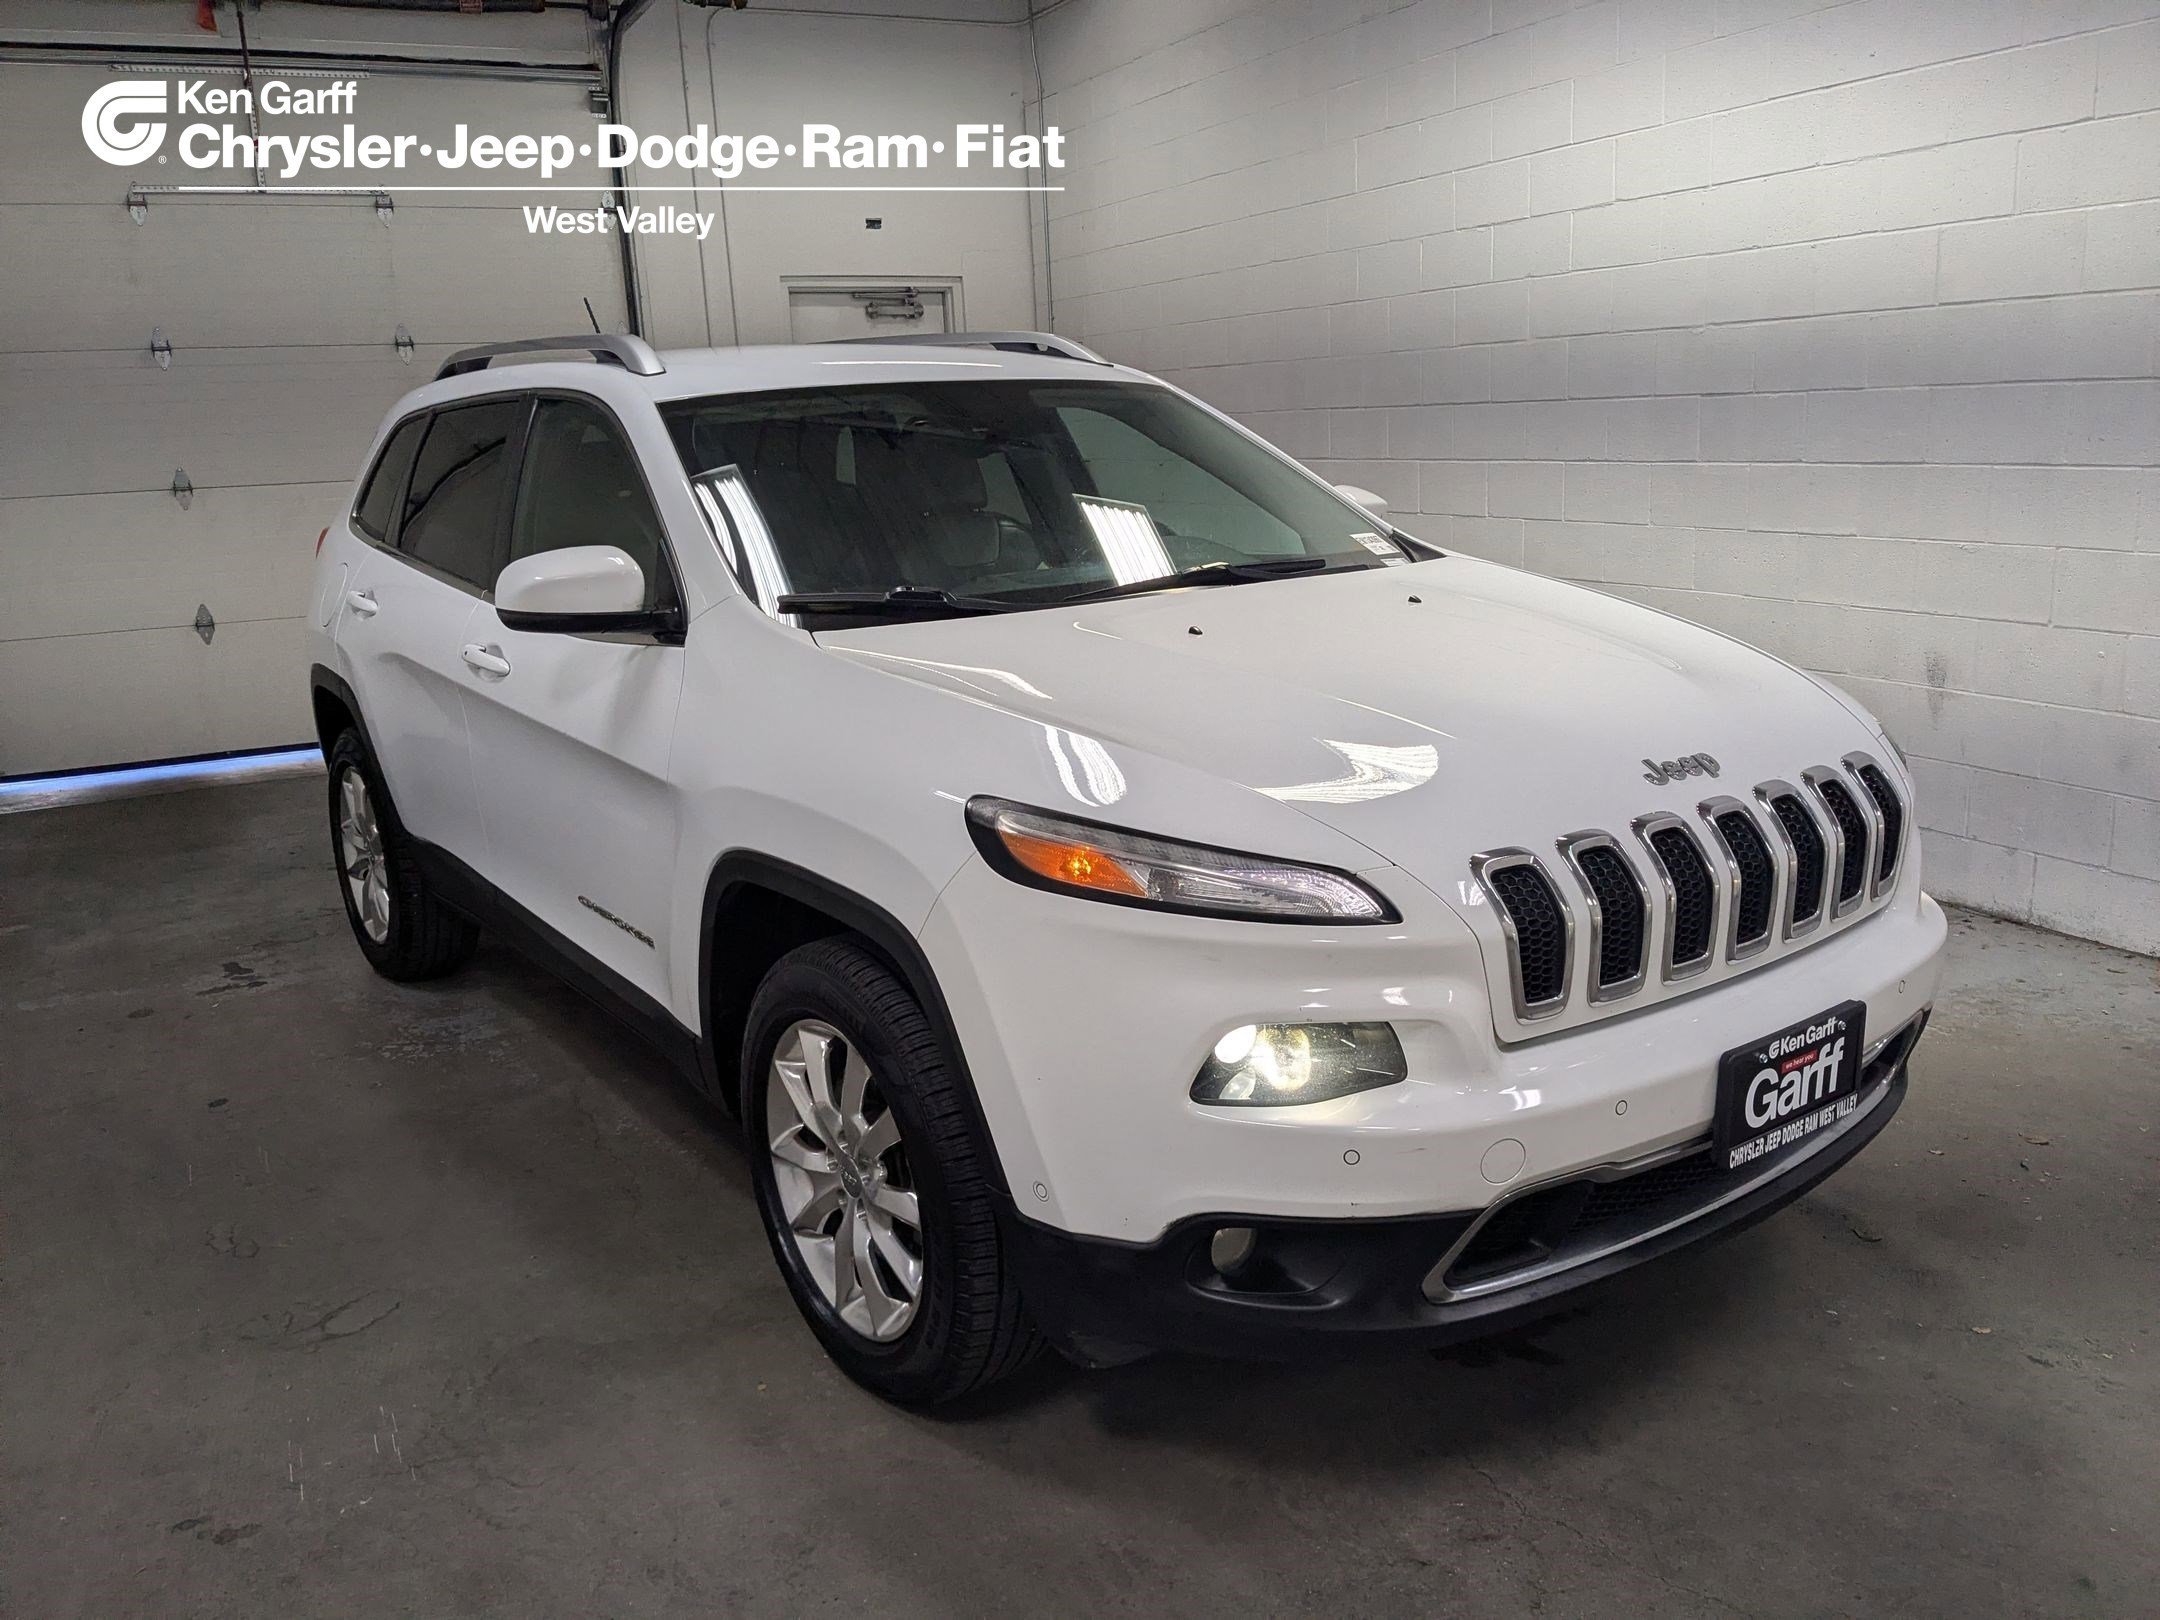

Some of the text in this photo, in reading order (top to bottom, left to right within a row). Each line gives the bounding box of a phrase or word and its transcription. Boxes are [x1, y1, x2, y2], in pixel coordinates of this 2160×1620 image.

[1641, 752, 1721, 786] Jeep
[1780, 1016, 1838, 1056] Ken Garff
[1745, 1037, 1845, 1129] Garff
[1729, 1093, 1858, 1169] CHRYSLER JEEP DODGE RAM WEST VALLEY
